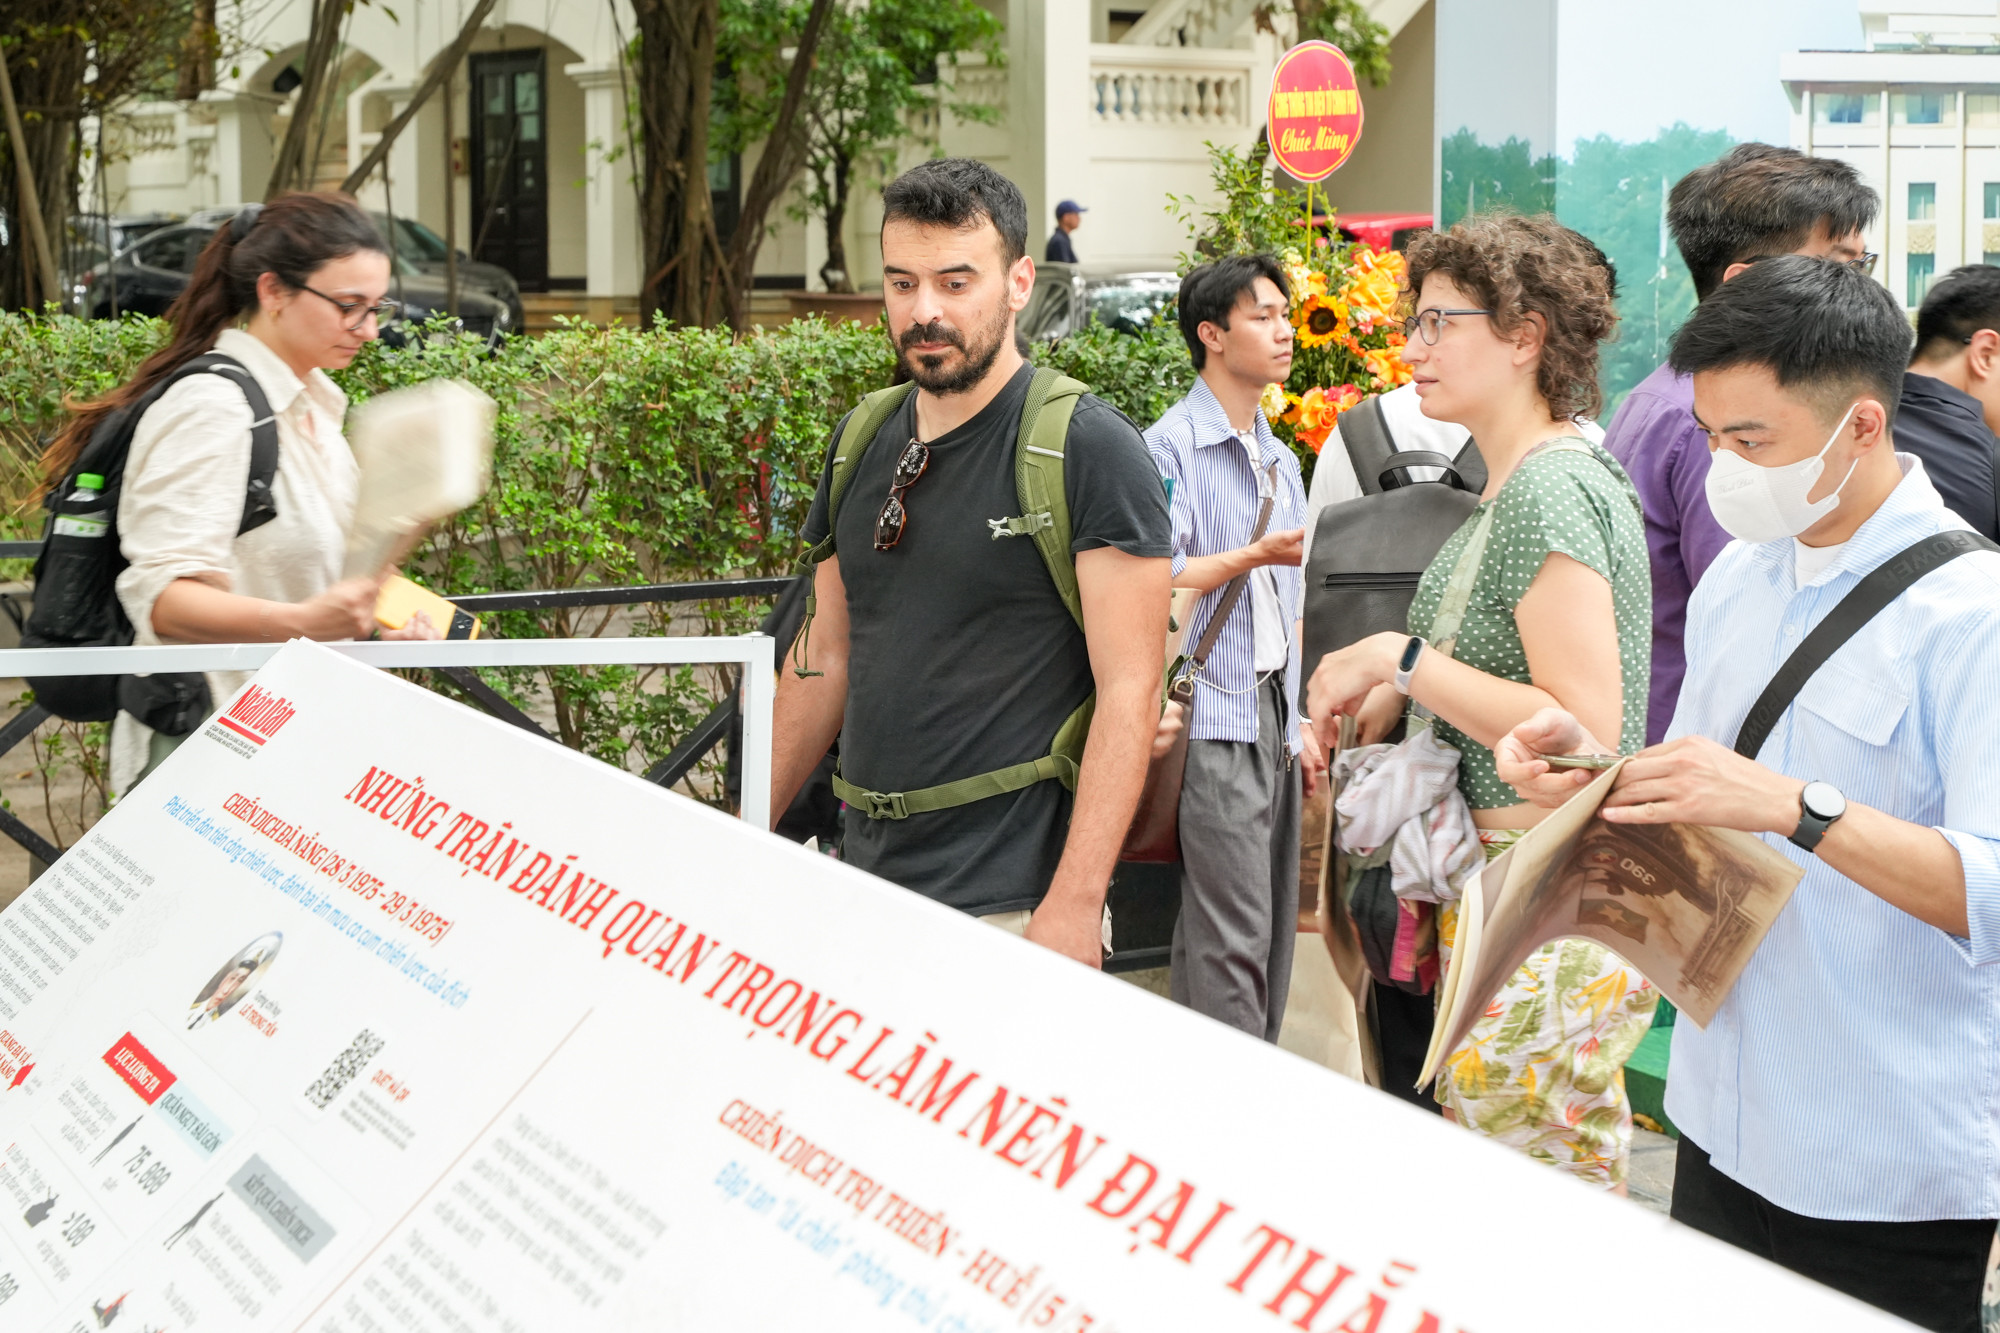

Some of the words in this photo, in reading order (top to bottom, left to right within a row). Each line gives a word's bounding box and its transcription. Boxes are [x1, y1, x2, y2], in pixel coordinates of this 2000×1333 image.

[1280, 127, 1312, 154] Chúc
[1738, 690, 1782, 757] POWE
[222, 793, 262, 823] CHIẾN
[250, 810, 286, 839] DỊCH
[274, 825, 302, 848] ĐÀ
[164, 796, 186, 817] Phát
[178, 807, 204, 828] triển
[194, 818, 214, 837] đòn
[208, 827, 228, 847] tiến
[222, 838, 246, 863] công
[240, 849, 266, 873] chiến
[280, 874, 307, 898] đánh
[299, 886, 319, 907] bại
[346, 922, 363, 938] co
[376, 941, 407, 966] chiến
[1620, 857, 1656, 886] 390
[344, 766, 451, 840] NHỮNG
[434, 812, 530, 882] TRẬN
[508, 851, 619, 931] ĐÁNH
[601, 900, 720, 984] QUAN
[703, 951, 863, 1063] TRỌNG
[845, 1027, 980, 1123] LÀM
[957, 1085, 1107, 1190] NÊN
[1086, 1153, 1235, 1263] ĐẠI
[1225, 1222, 1477, 1333] THẮ
[718, 1099, 790, 1152] CHIẾN
[778, 1135, 844, 1187] DỊCH
